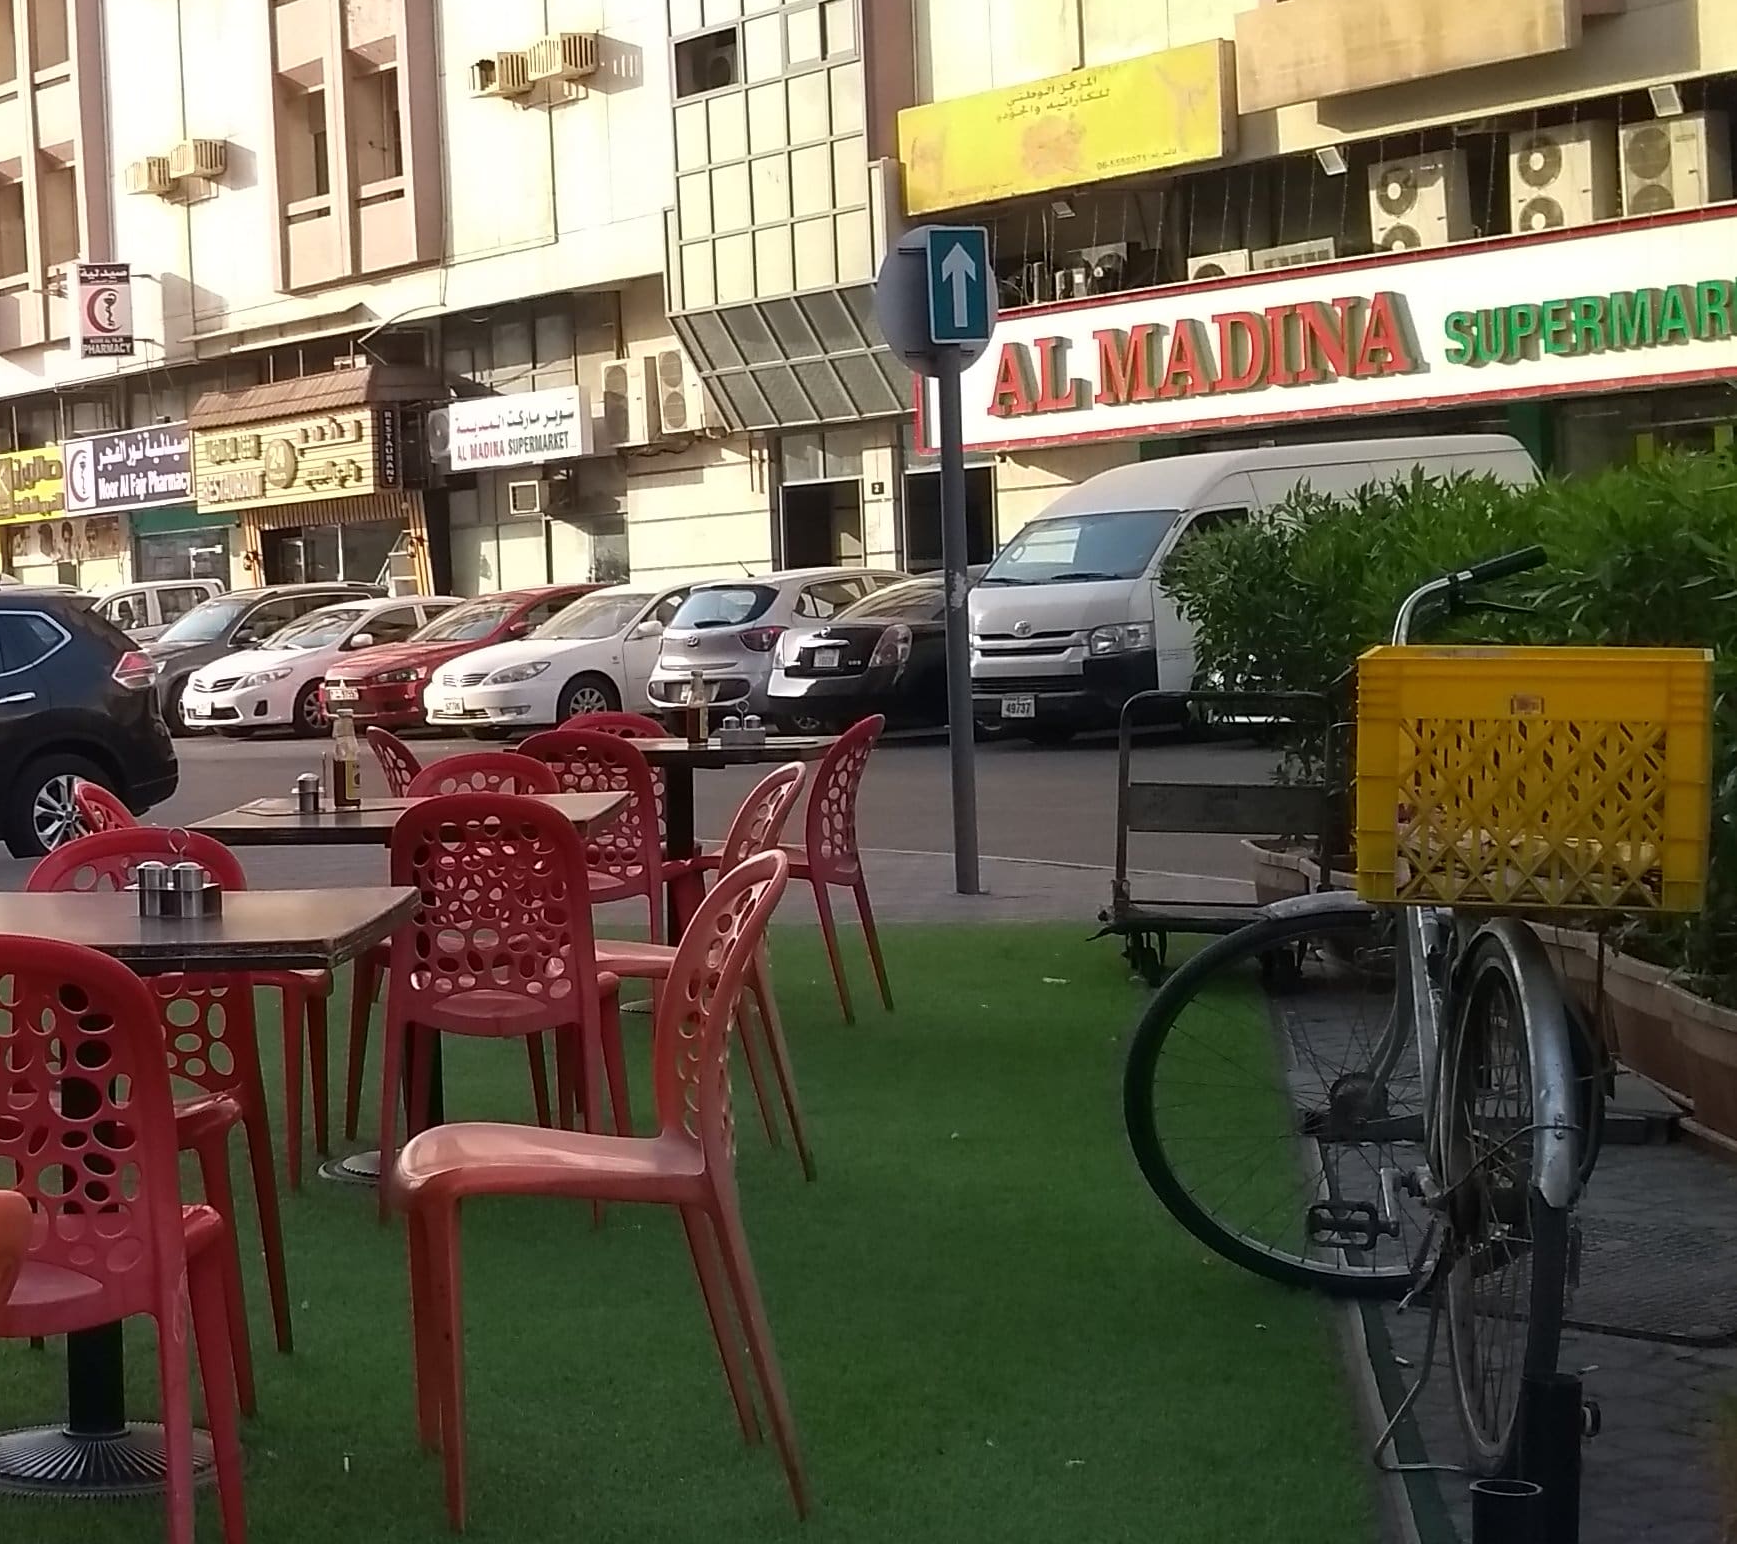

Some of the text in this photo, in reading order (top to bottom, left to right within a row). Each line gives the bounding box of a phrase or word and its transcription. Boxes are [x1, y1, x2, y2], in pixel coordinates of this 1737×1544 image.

[78, 267, 128, 280] صيدلية
[81, 342, 132, 355] PHARMACY
[987, 277, 1737, 417] AL MADINA SUPERMAR
[506, 409, 540, 430] ماركت
[543, 408, 575, 428] سوبر
[97, 437, 127, 472] الفجر
[126, 433, 144, 467] نور
[144, 432, 190, 462] صيدلية
[269, 445, 286, 470] 24
[383, 410, 395, 483] RESTAURANT
[457, 431, 569, 462] AL MADINA SUPERMARKET
[97, 470, 192, 501] Noor Al Fajr Pharmacy
